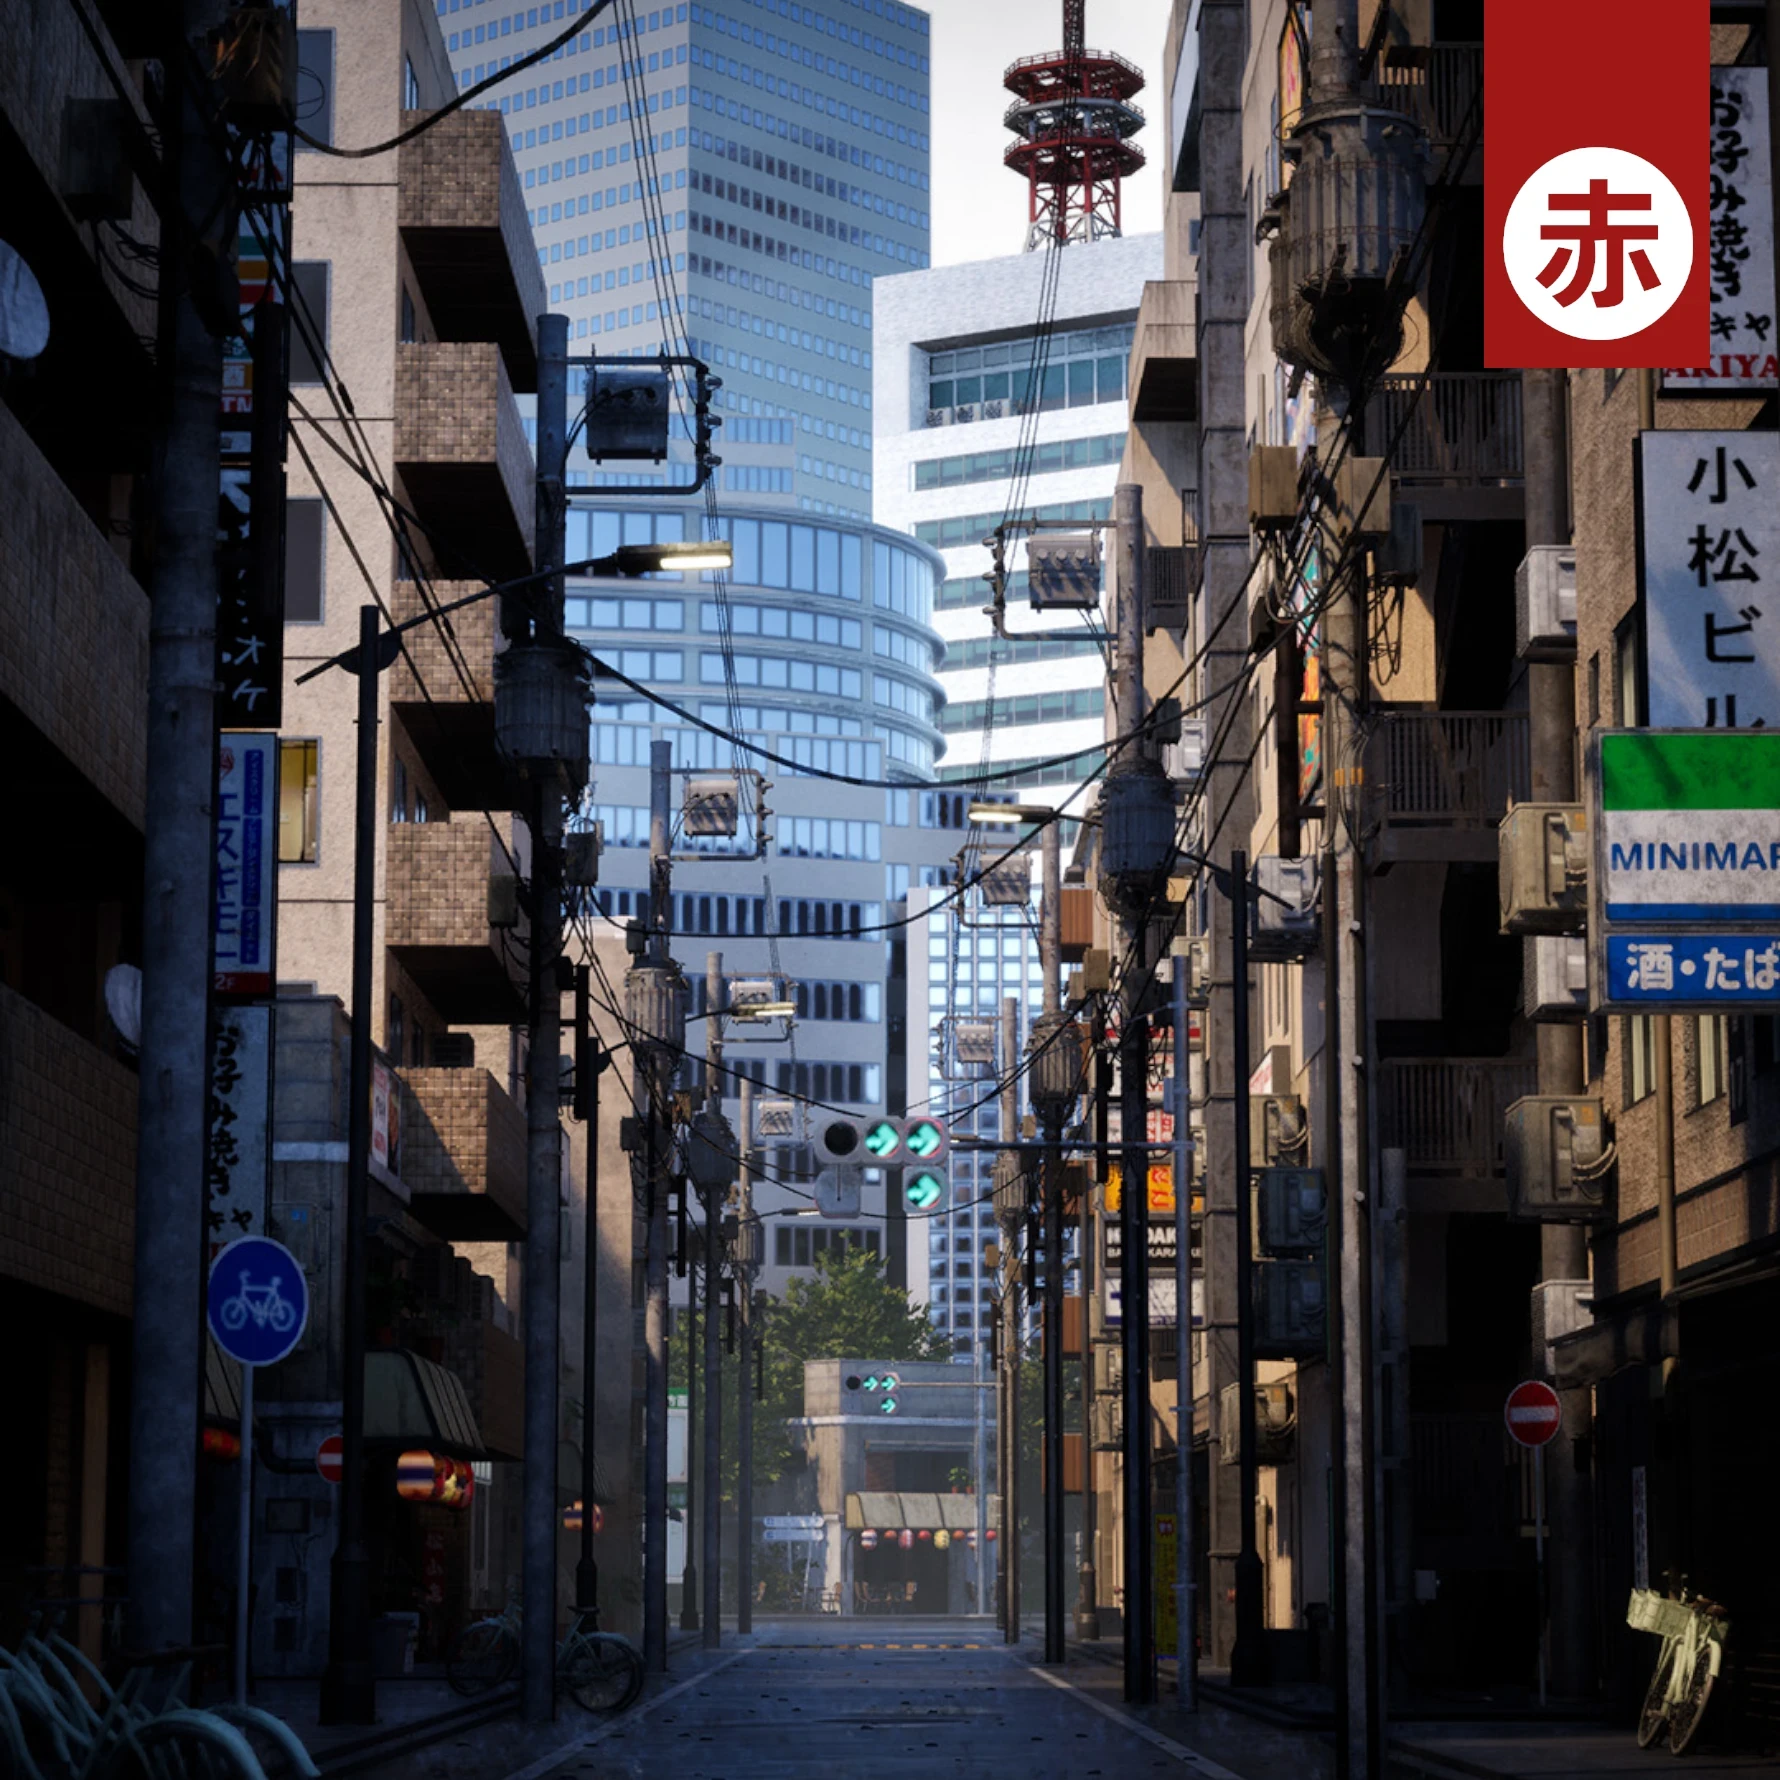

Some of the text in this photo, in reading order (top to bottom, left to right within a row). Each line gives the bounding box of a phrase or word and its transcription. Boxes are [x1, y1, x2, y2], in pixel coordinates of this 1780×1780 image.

[1687, 447, 1766, 727] 小松ビル
[215, 974, 235, 990] 2F
